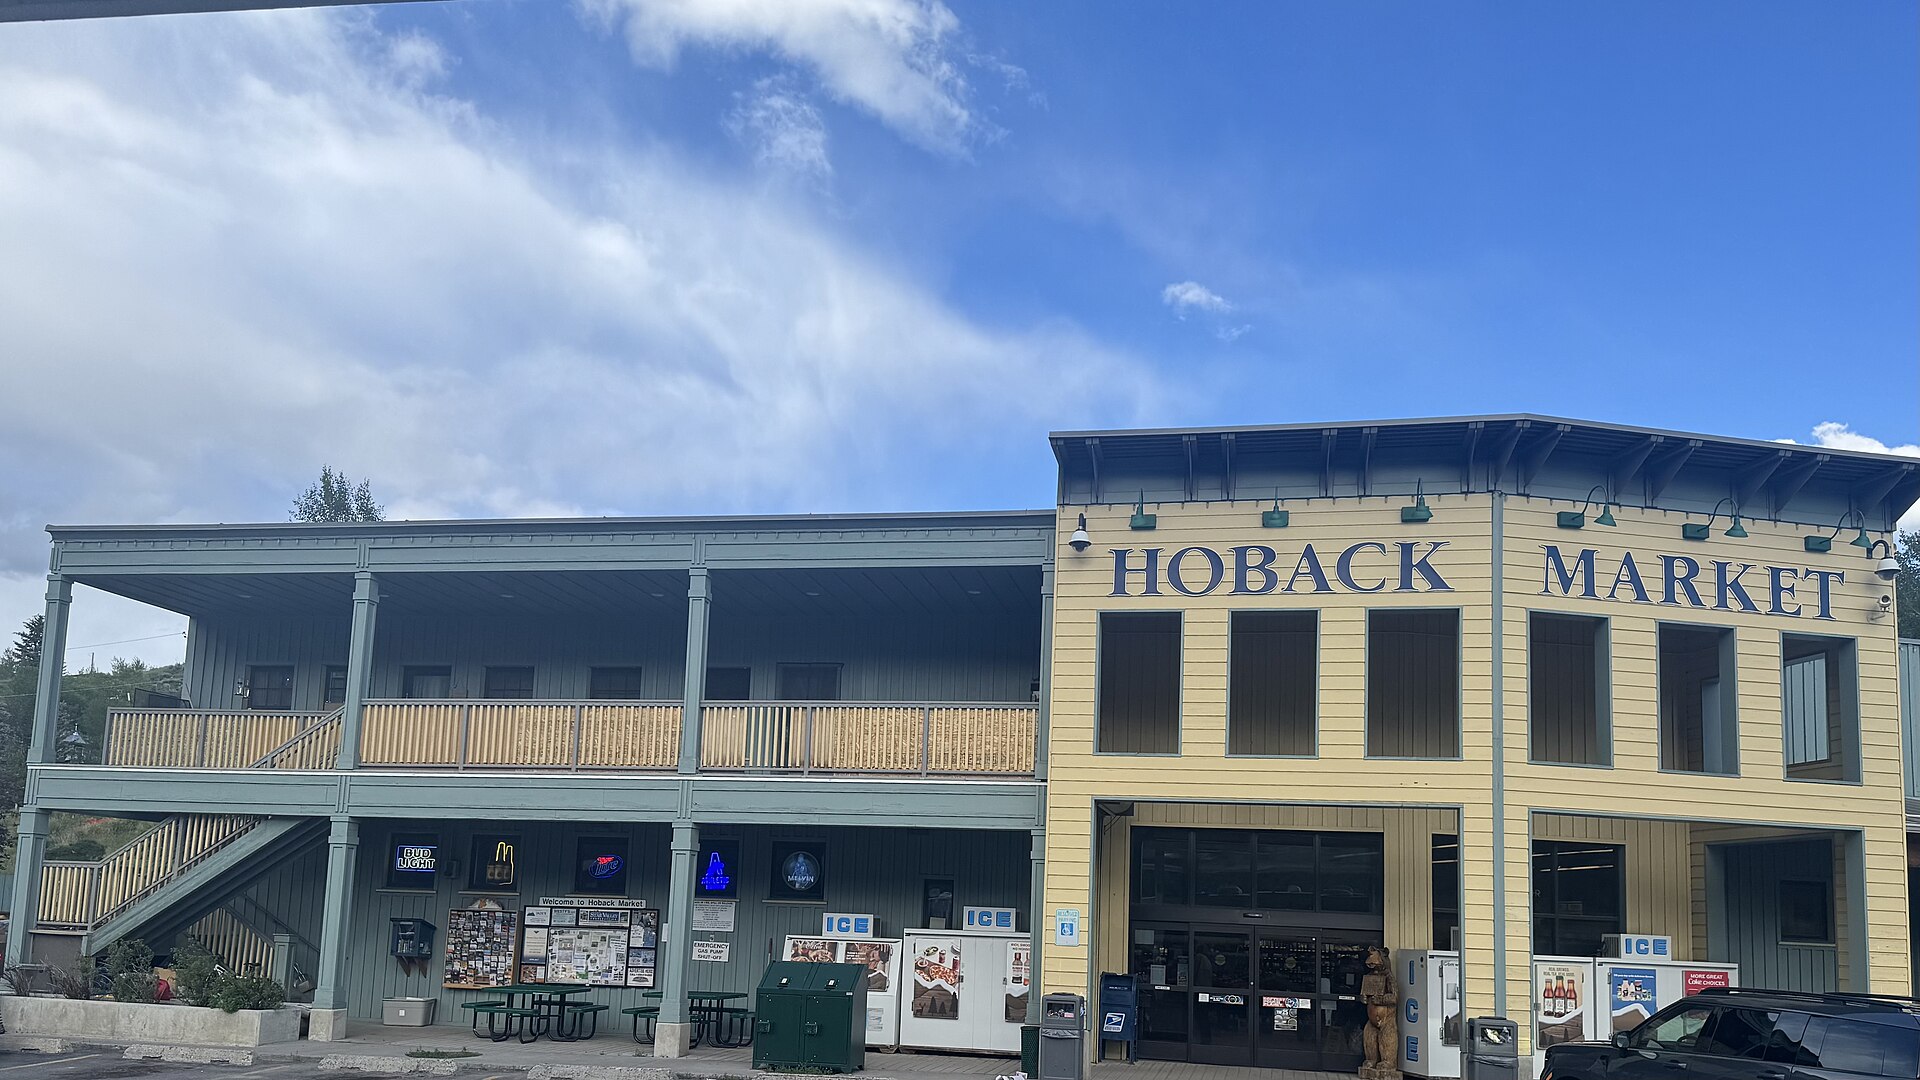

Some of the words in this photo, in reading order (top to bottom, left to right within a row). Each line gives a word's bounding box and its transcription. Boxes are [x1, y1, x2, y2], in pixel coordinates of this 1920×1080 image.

[1107, 541, 1455, 597] HOBACK
[1537, 544, 1845, 621] MARKET
[403, 848, 431, 859] BUD
[398, 858, 436, 869] LIGHT
[787, 875, 814, 883] MELVIN
[588, 899, 615, 907] Hoback
[826, 916, 869, 933] ICE
[967, 910, 1012, 927] ICE
[1625, 938, 1667, 955] ICE
[1687, 978, 1703, 986] Coke
[1405, 960, 1419, 1062] ICE
